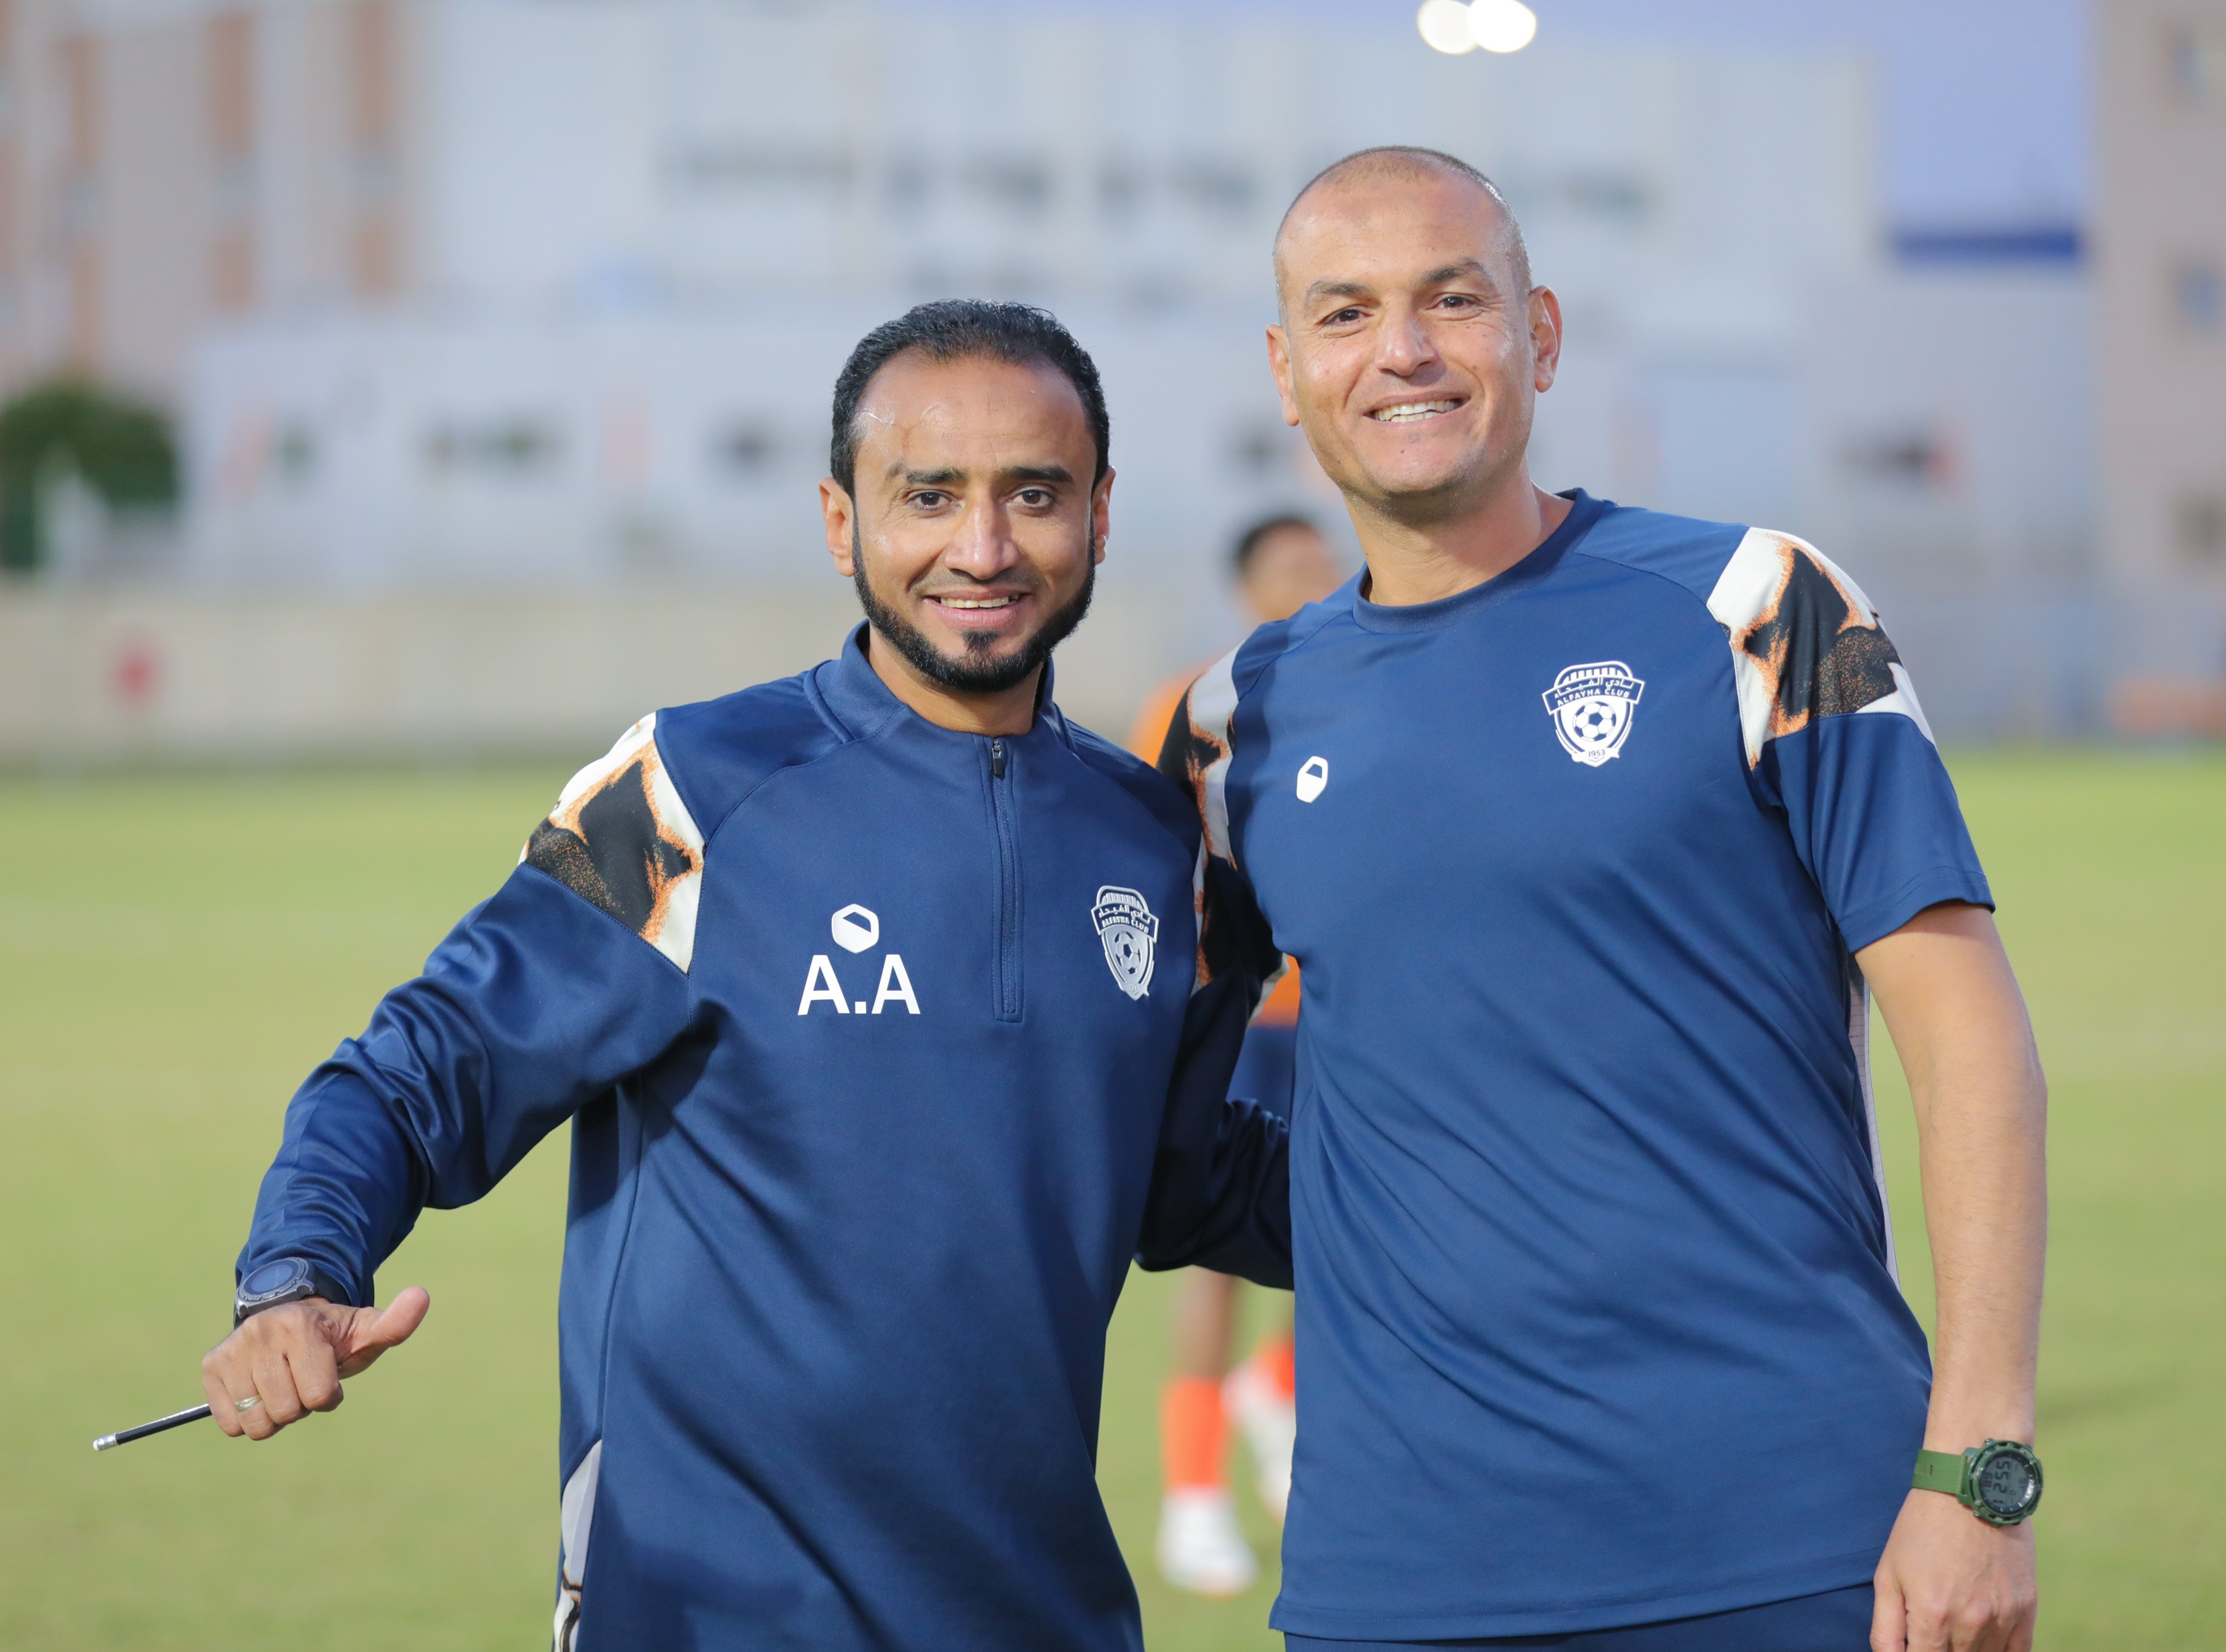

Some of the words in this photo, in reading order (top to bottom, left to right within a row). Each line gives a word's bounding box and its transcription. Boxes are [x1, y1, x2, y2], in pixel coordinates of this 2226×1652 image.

[1554, 677, 1603, 699] الفيحاء
[1605, 678, 1634, 690] نادي
[1557, 688, 1600, 706] ALFAYHA
[1604, 688, 1629, 698] CLUB
[1588, 749, 1606, 757] 1953
[1101, 915, 1130, 928] ALFAYHA
[1131, 919, 1149, 934] CLUB
[798, 954, 921, 1016] A.A
